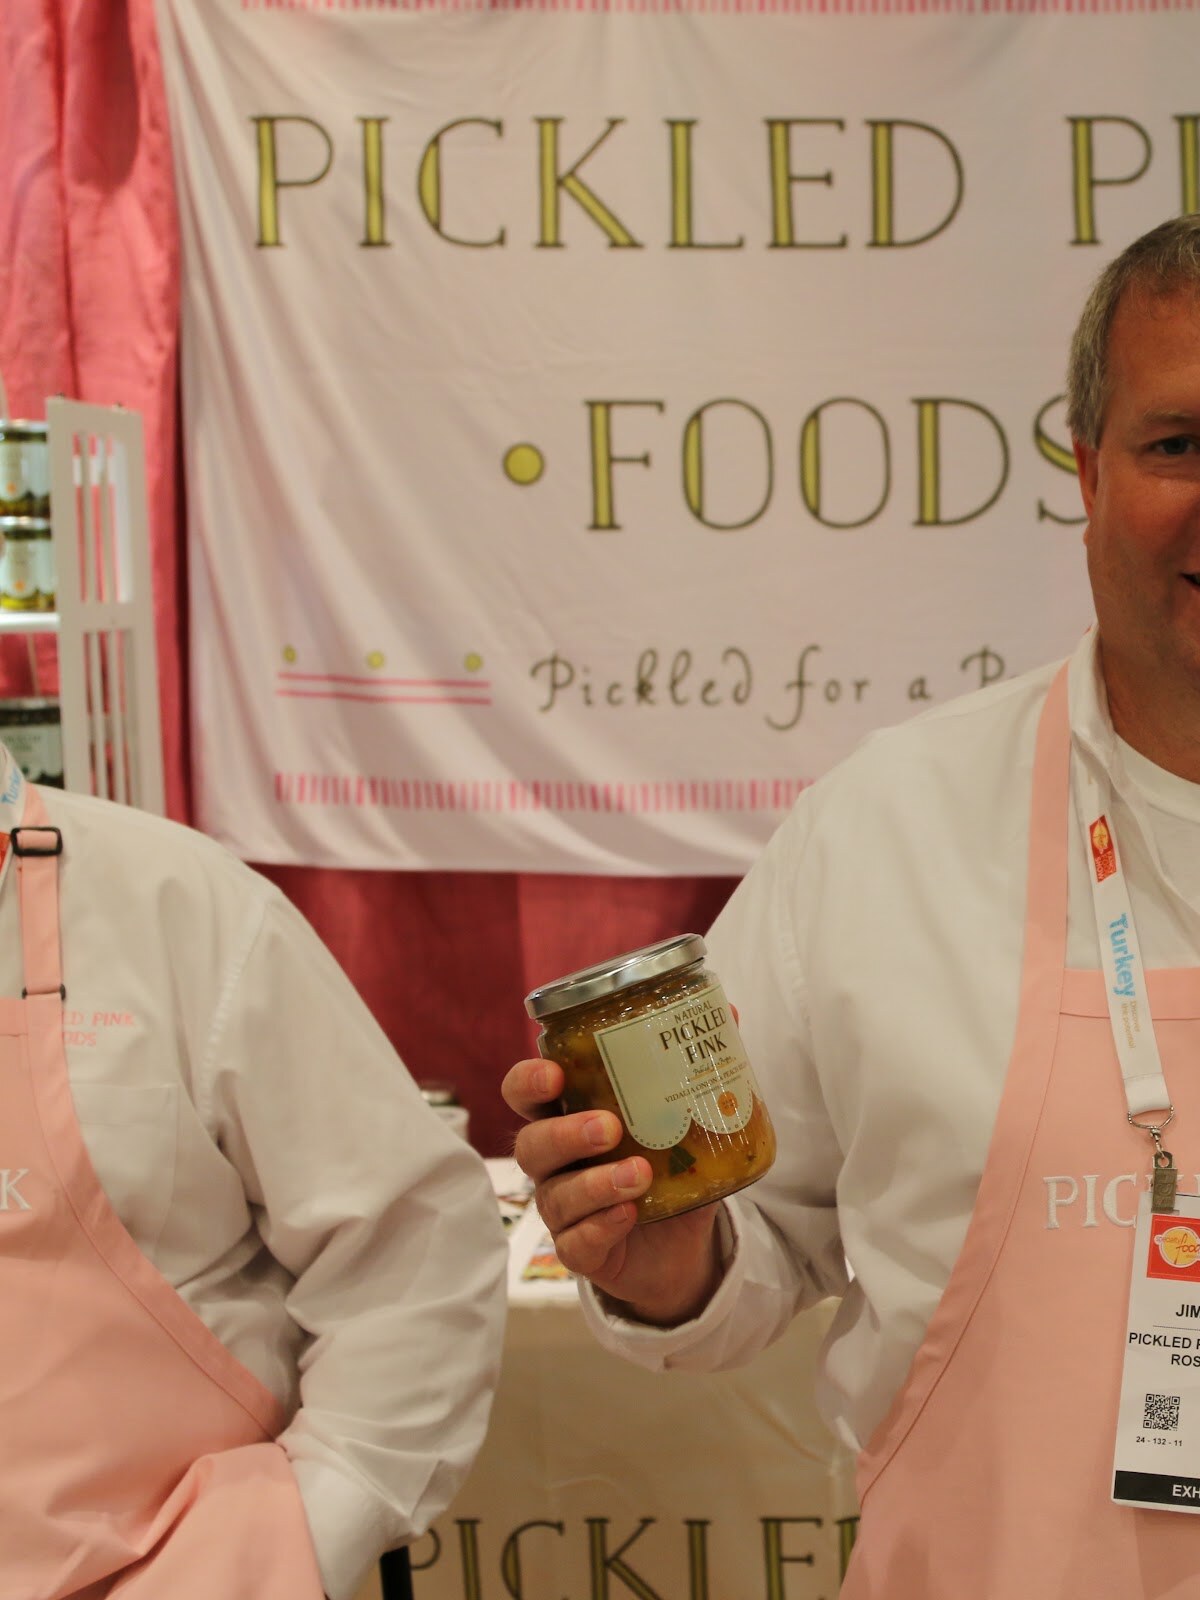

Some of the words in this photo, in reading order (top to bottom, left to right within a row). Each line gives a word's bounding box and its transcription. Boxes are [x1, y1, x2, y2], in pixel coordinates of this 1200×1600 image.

[250, 115, 964, 249] PICKLED
[530, 646, 752, 713] Pickled
[765, 644, 870, 731] for
[907, 675, 931, 702] a
[1109, 912, 1136, 997] Turkey
[674, 1000, 712, 1024] NATURAL
[659, 1006, 727, 1051] PICKLED
[685, 1032, 727, 1064] PINK
[664, 1086, 696, 1103] VIDALIA
[1128, 1332, 1192, 1349] PICKLED
[1153, 1438, 1167, 1446] 132
[1174, 1439, 1183, 1447] 11
